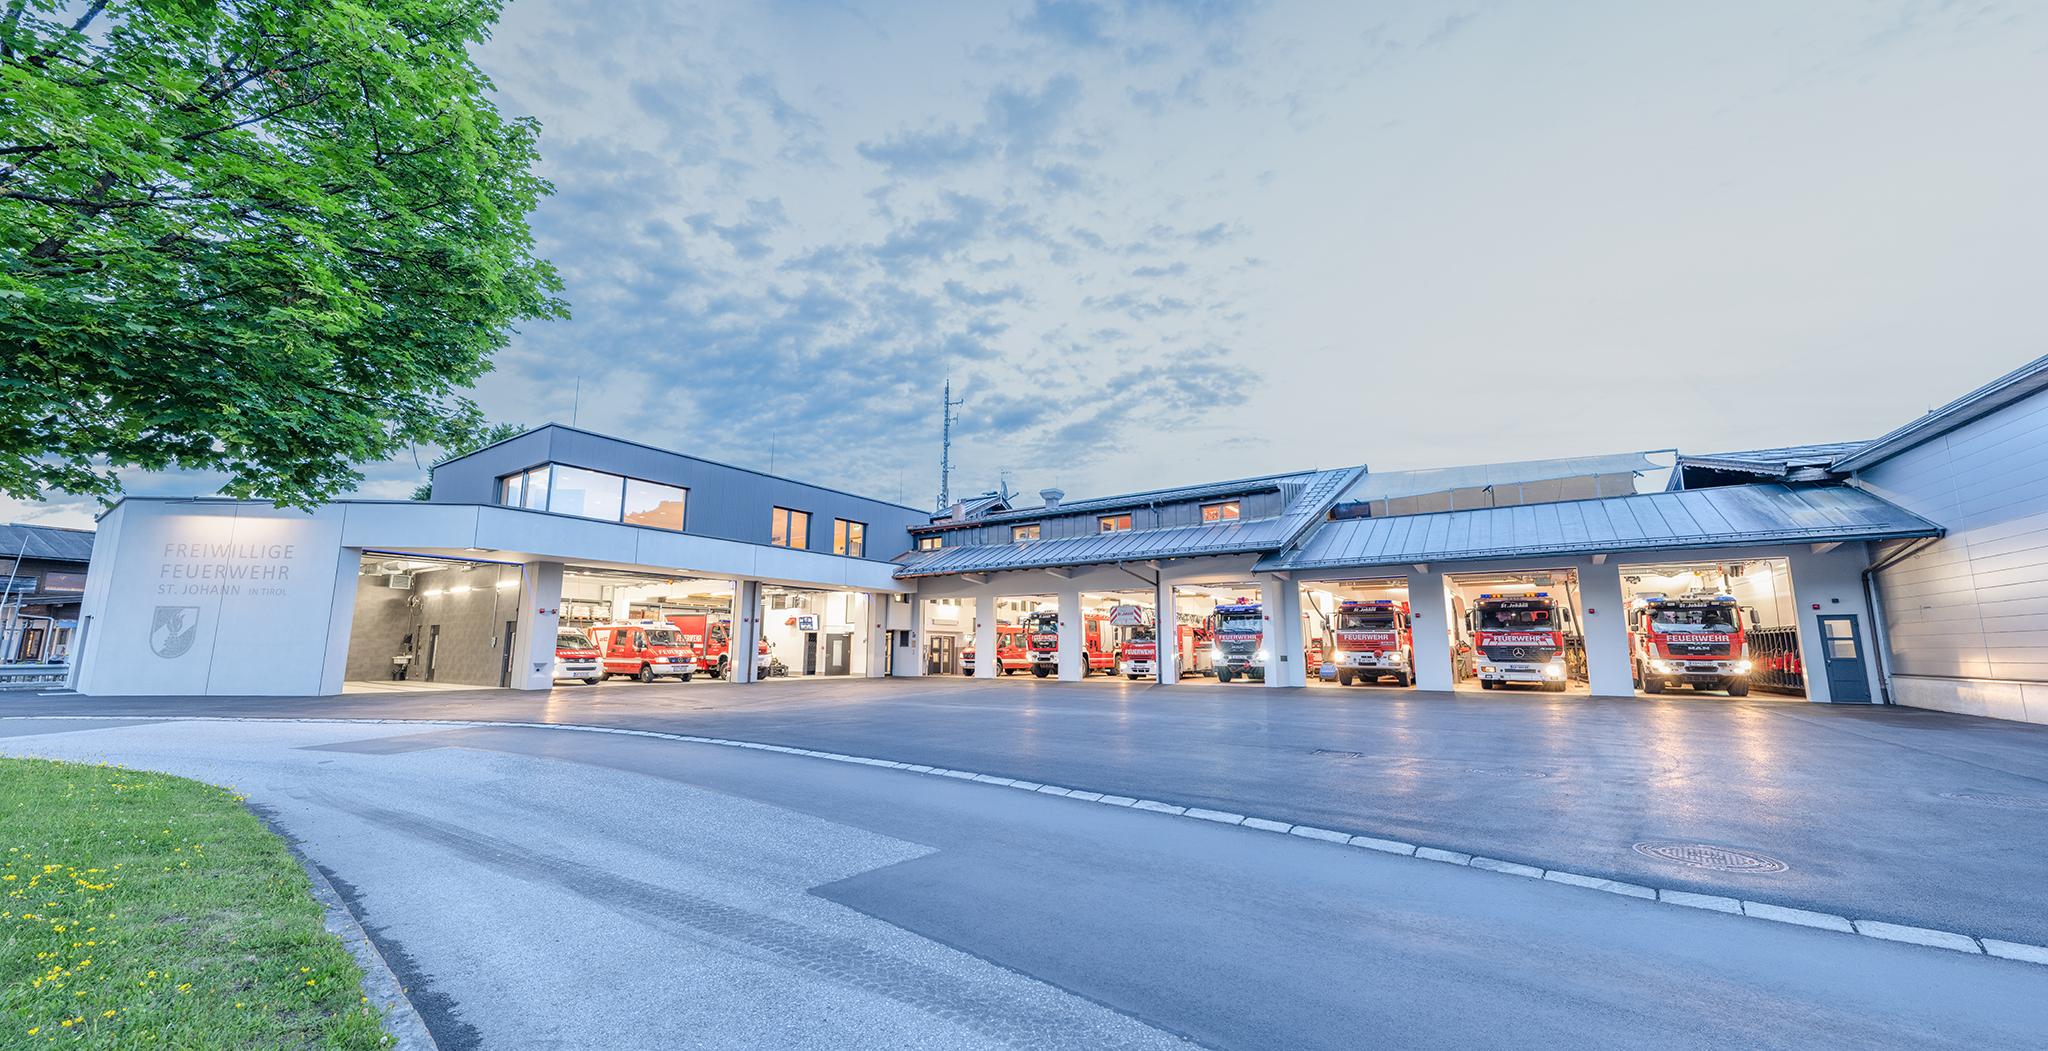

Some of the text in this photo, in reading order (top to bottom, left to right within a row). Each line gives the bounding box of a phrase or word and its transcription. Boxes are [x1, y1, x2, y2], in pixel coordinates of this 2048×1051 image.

[164, 543, 295, 559] FREIWILLIGE
[160, 564, 289, 580] FEUERWEHR
[158, 584, 287, 597] ST. JOHANN IN TIROL
[1666, 634, 1730, 642] FEUERWEHR
